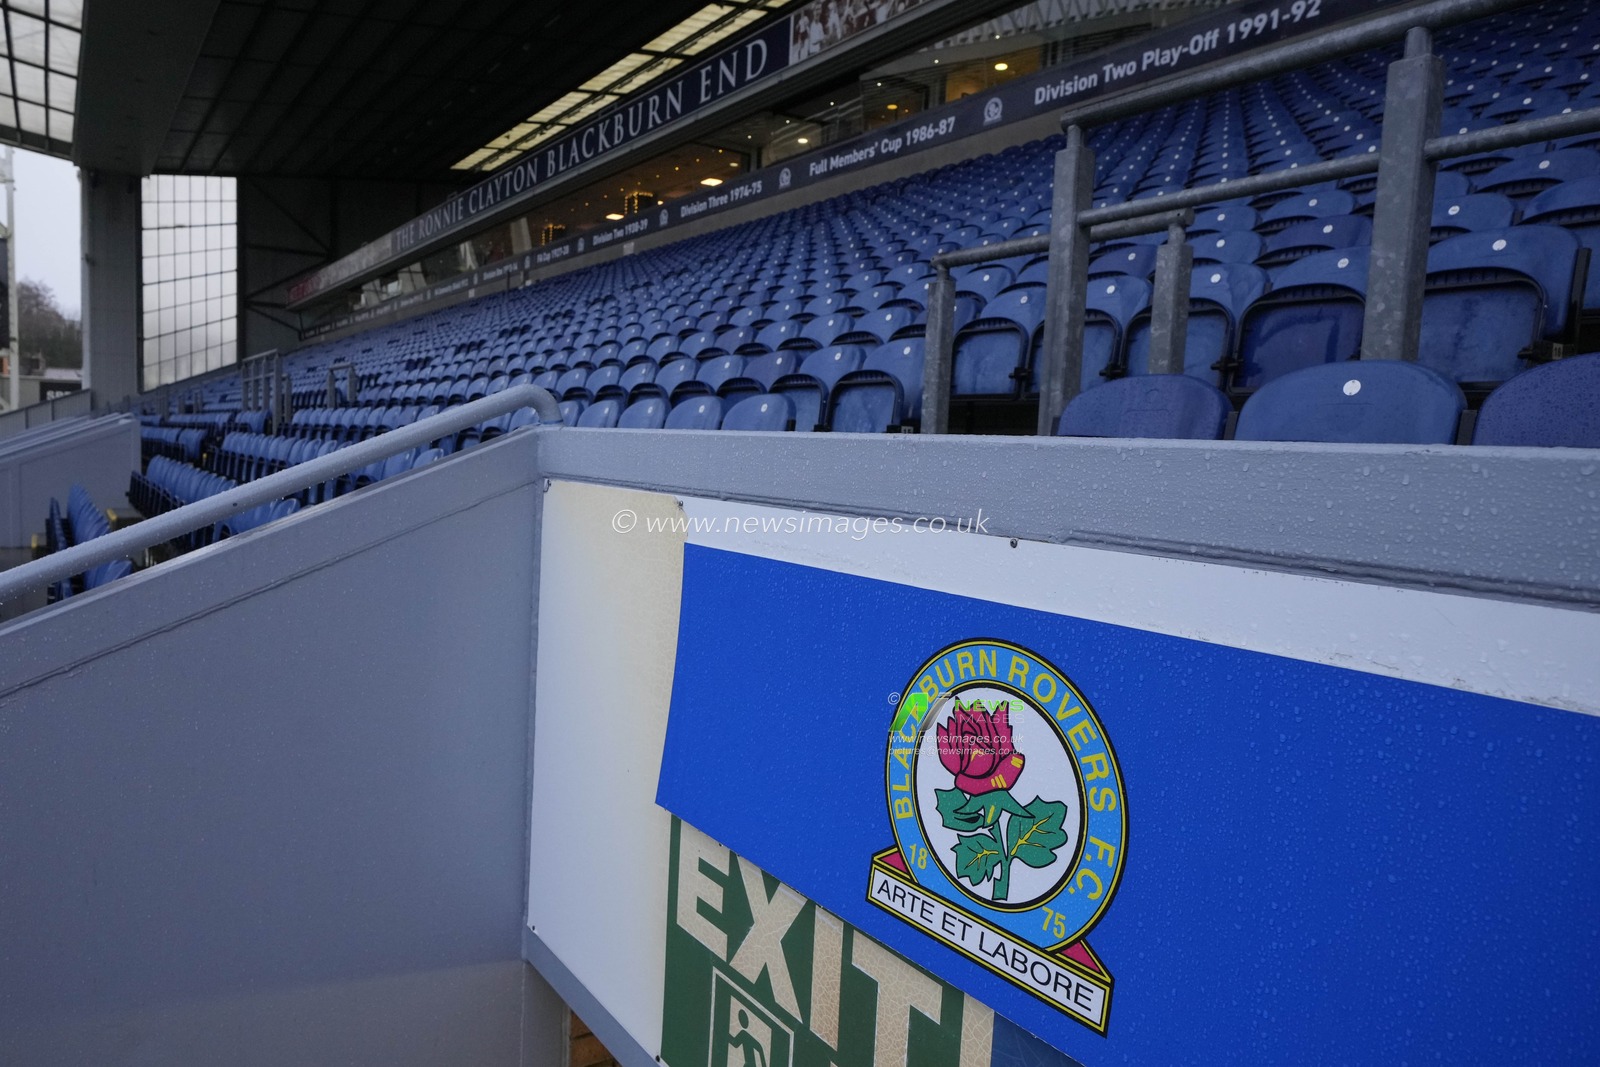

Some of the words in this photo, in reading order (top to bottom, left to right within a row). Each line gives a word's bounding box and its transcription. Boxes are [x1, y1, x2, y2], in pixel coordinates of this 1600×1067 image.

[1034, 72, 1098, 105] Division
[1102, 59, 1137, 83] Two
[1142, 28, 1220, 71] Play-Off
[1226, 0, 1321, 44] 1991-92
[396, 227, 416, 249] THE
[419, 193, 464, 240] RONNIE
[469, 158, 538, 214] CLAYTON
[547, 80, 684, 178] BLACKBURN
[700, 38, 768, 104] END
[809, 161, 828, 176] Full
[881, 136, 903, 154] Cup
[905, 116, 956, 146] 1986-87
[680, 201, 708, 218] Division
[708, 194, 728, 209] Three
[1007, 655, 1117, 812] ROVERS
[1068, 836, 1116, 900] F.C.
[908, 843, 928, 870] 18
[676, 818, 943, 1067] EXIT
[877, 879, 934, 924] ARTE
[941, 911, 973, 941] ET
[978, 931, 1094, 1012] LABORE
[1041, 905, 1066, 939] 75
